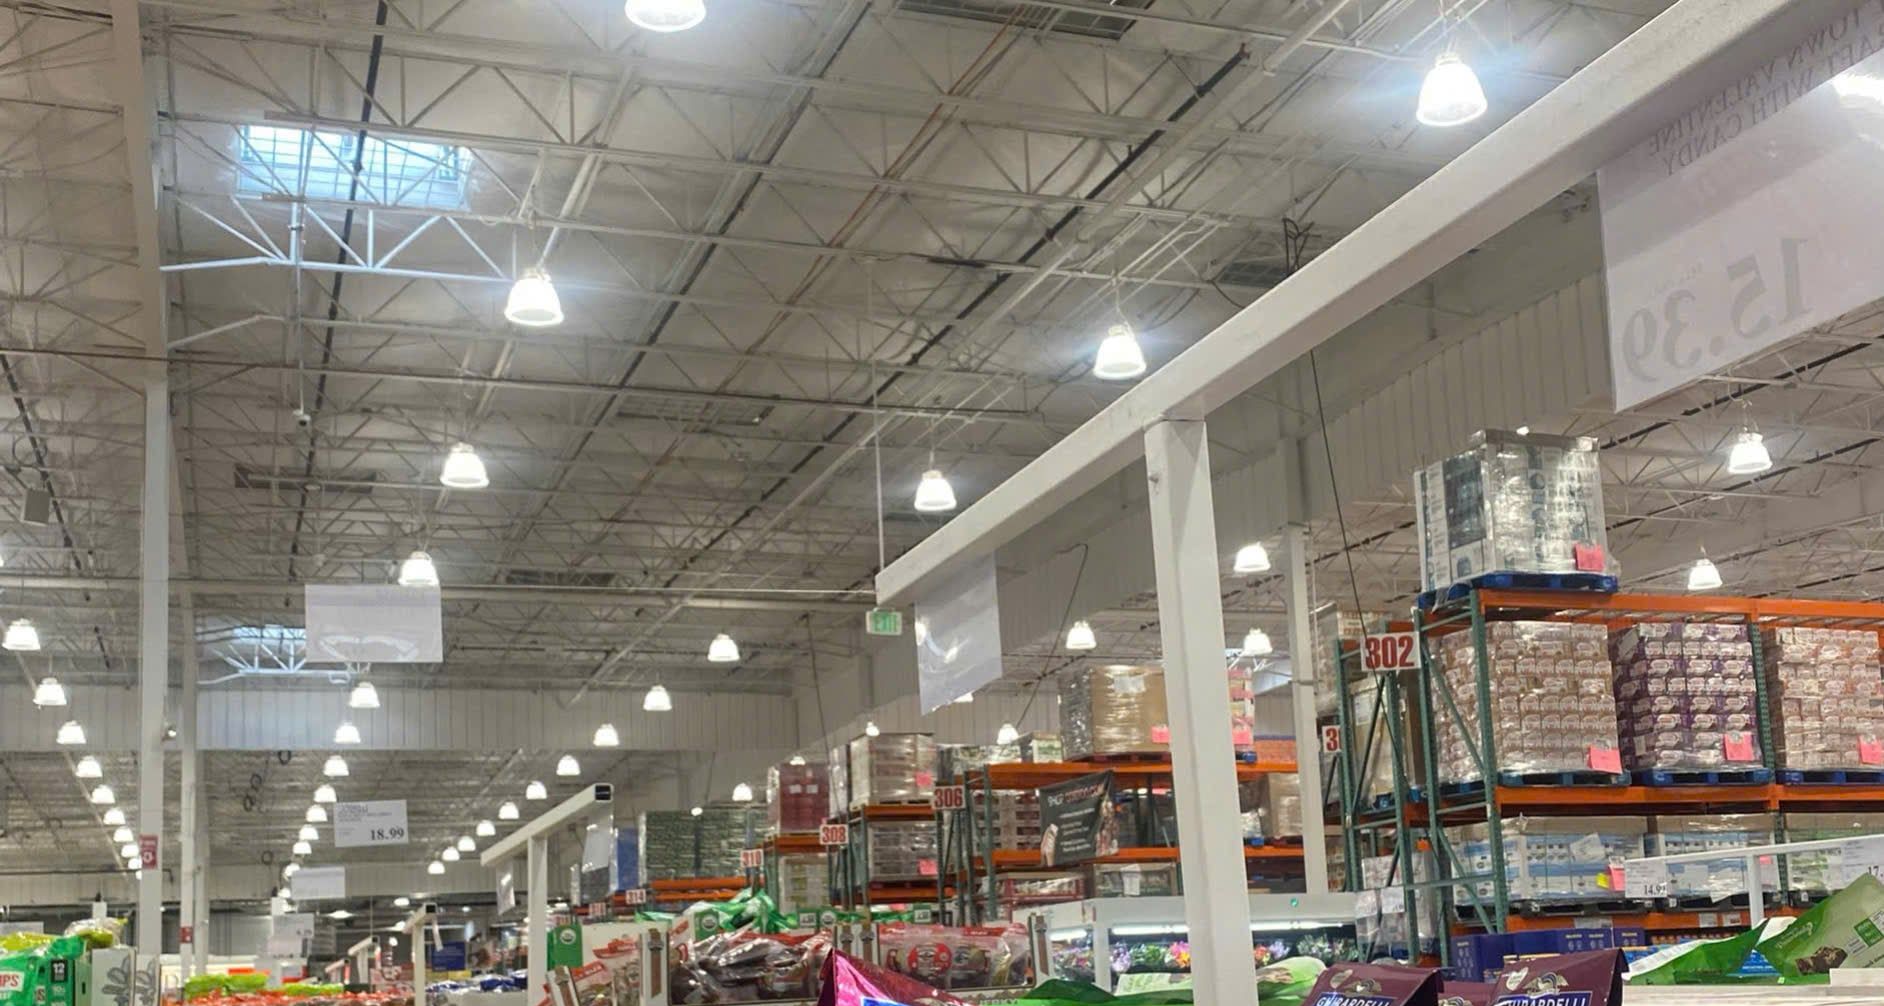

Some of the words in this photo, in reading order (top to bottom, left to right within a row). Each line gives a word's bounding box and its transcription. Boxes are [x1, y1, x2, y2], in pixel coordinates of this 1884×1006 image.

[1365, 635, 1415, 670] 302
[1326, 727, 1341, 751] 3
[934, 787, 962, 808] 306
[370, 826, 404, 841] 18.99
[822, 826, 847, 844] 308
